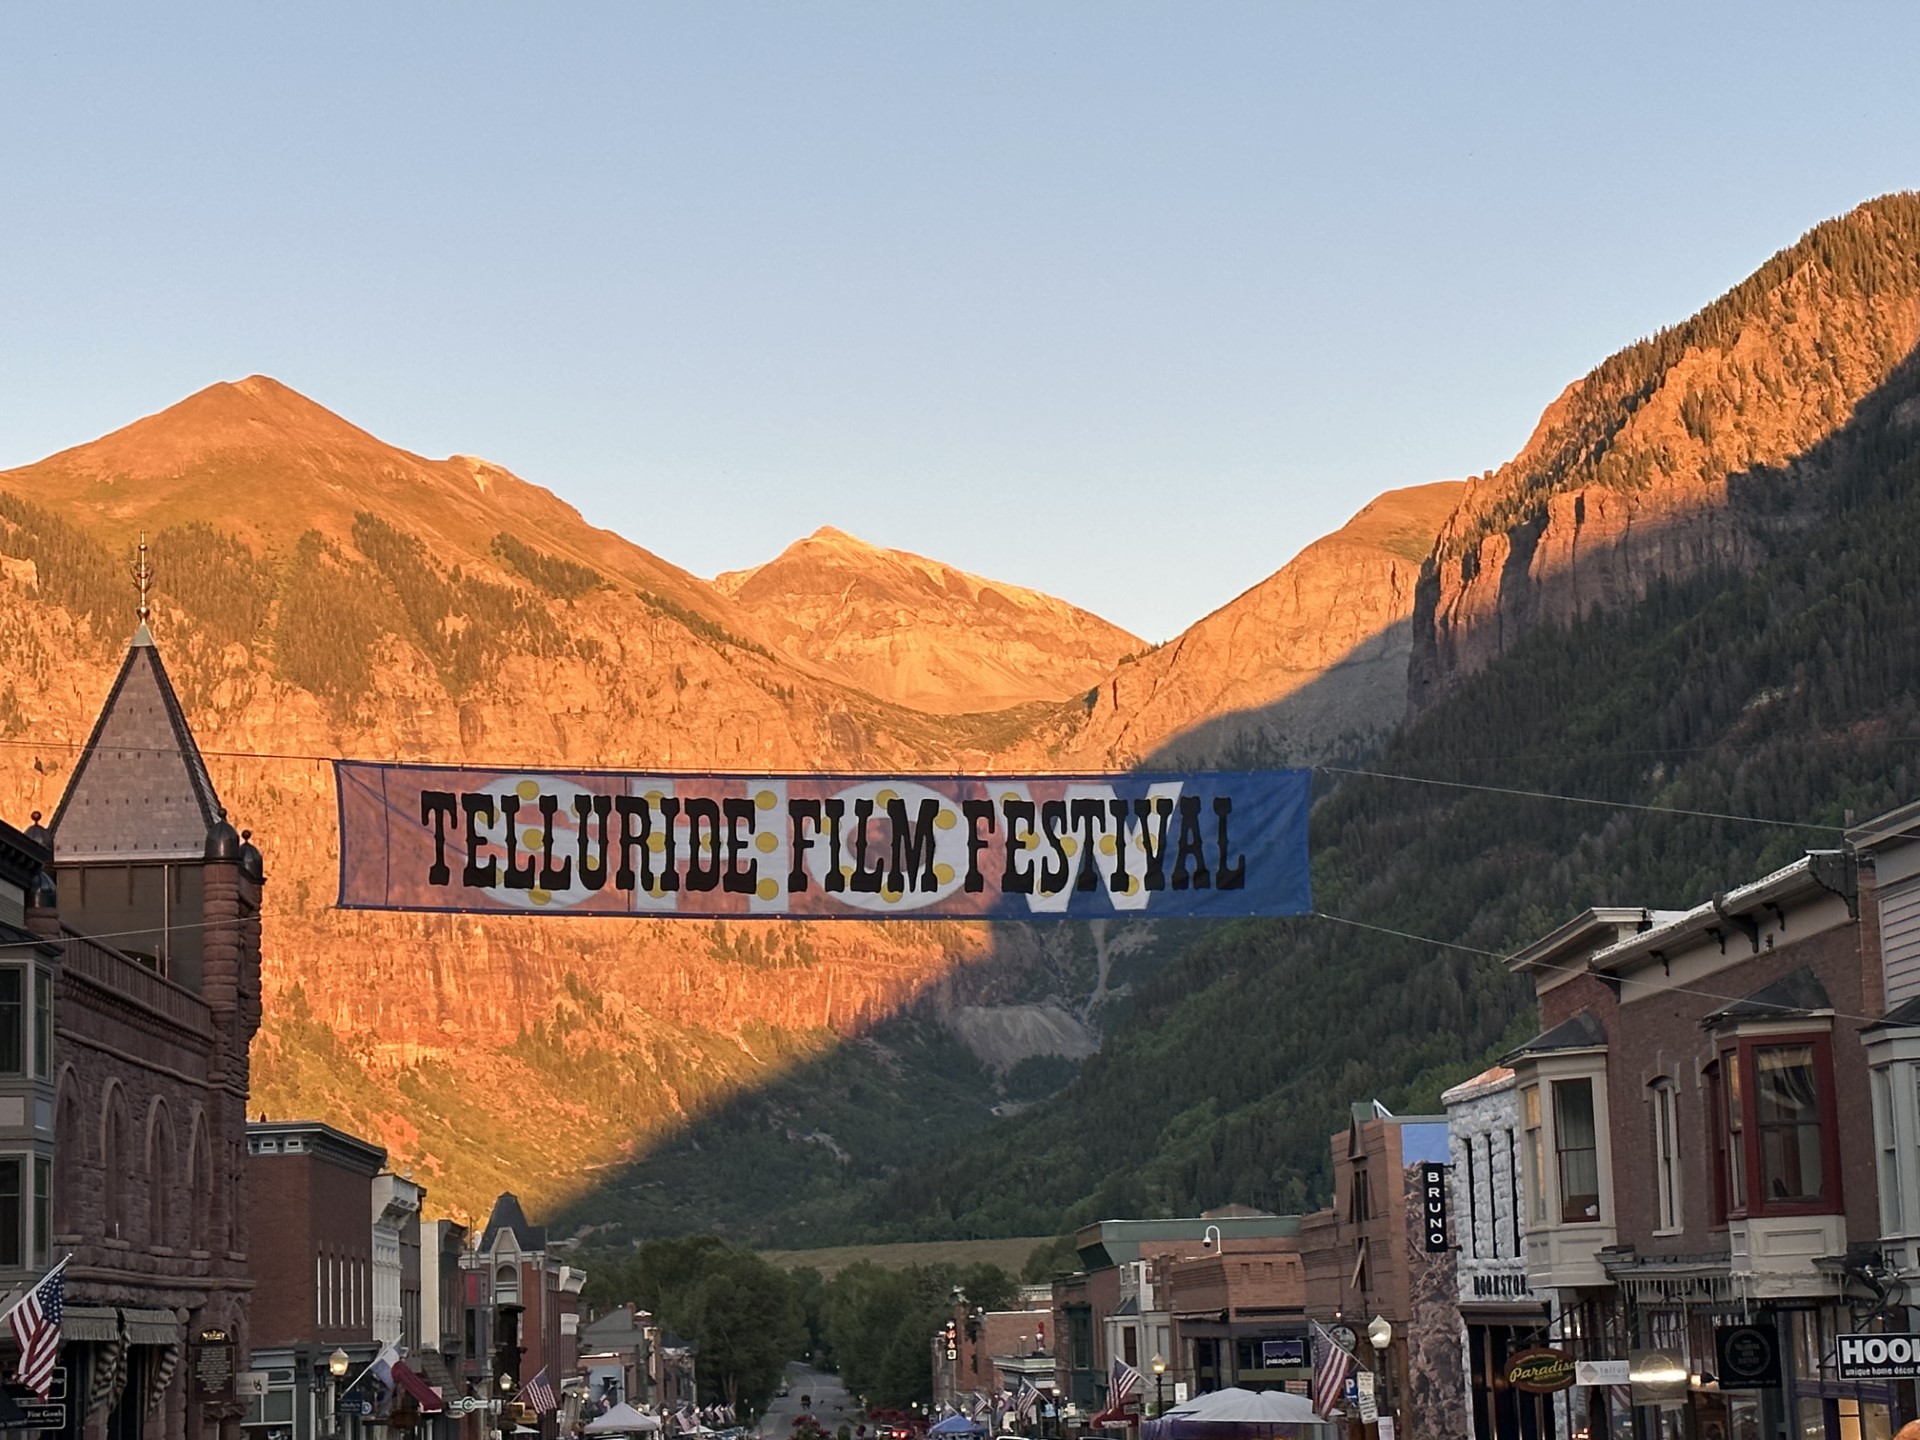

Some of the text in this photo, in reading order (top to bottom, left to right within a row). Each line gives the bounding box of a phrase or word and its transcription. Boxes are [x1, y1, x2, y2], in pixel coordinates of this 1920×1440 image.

[420, 790, 1246, 894] TELLURIDE FILM FESTIVAL
[1427, 1172, 1443, 1244] BRUNO
[1473, 1274, 1534, 1296] BOOKSTOR
[1845, 1367, 1871, 1376] unique
[1872, 1366, 1893, 1375] home
[1345, 1378, 1355, 1394] P
